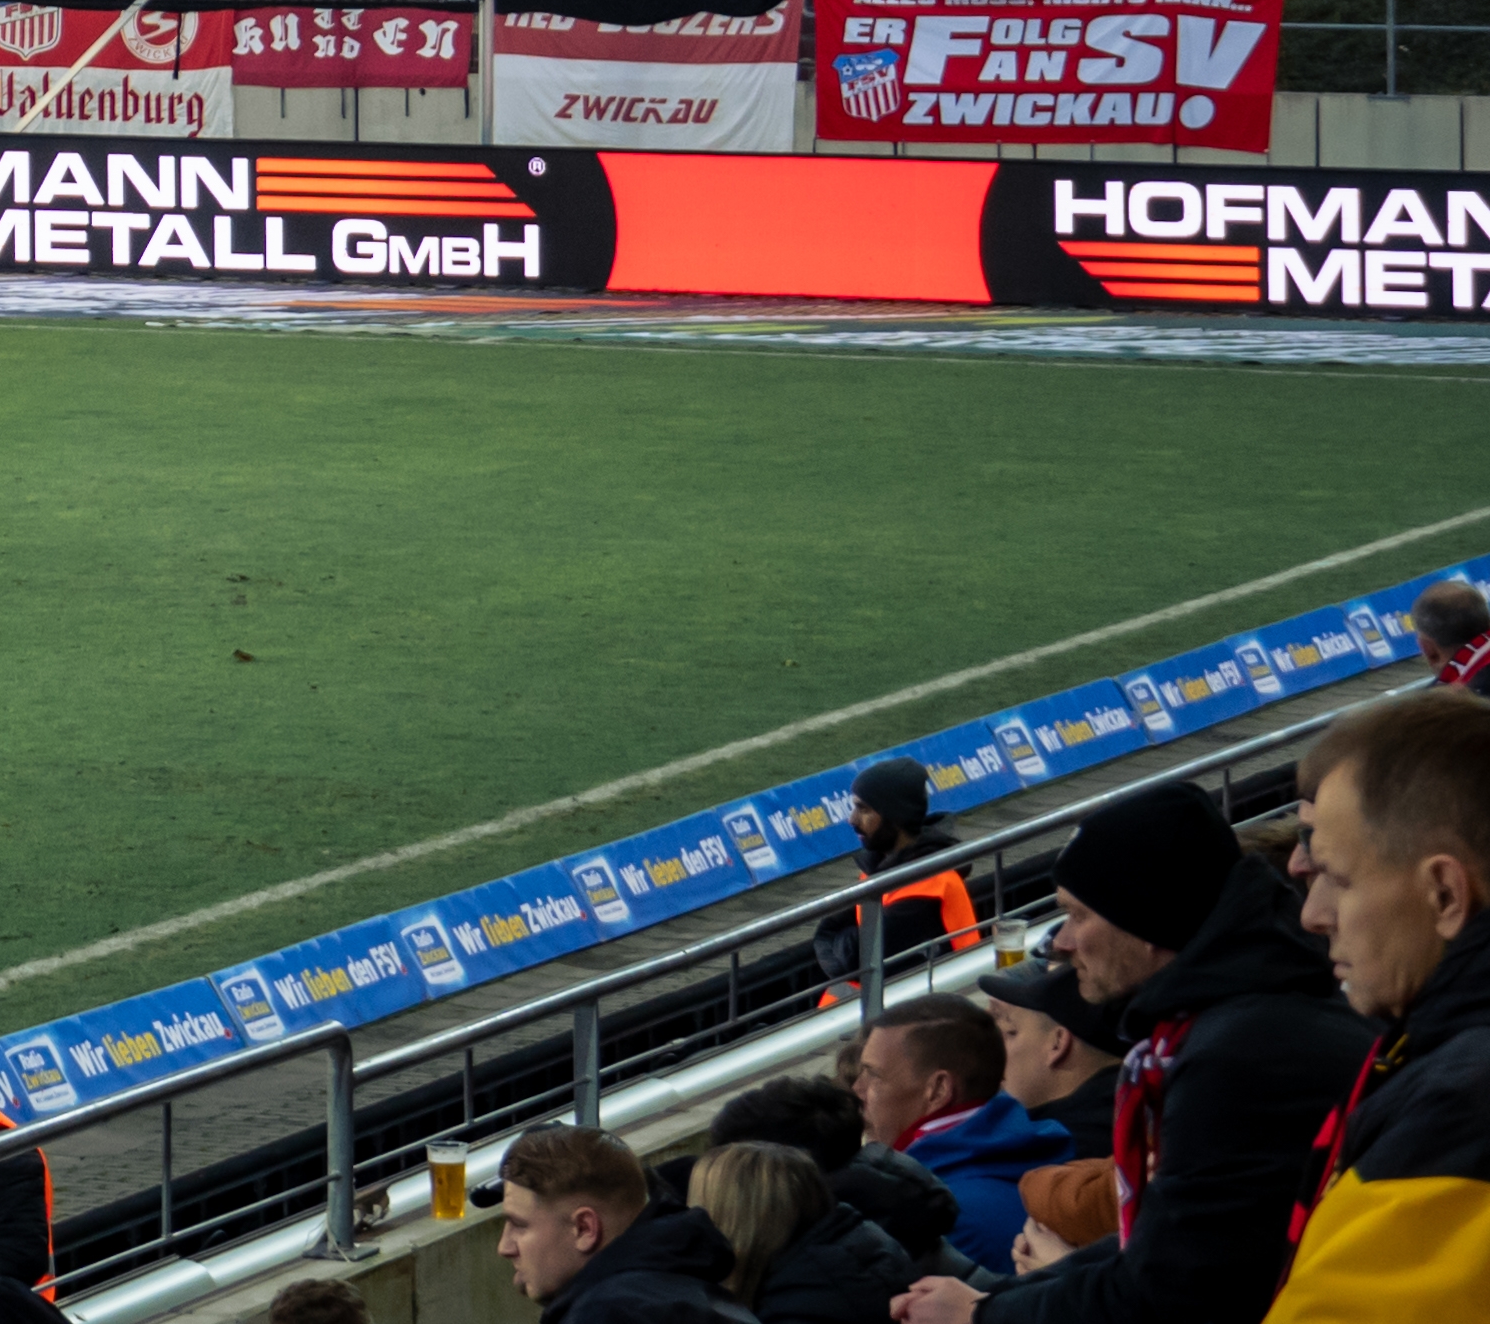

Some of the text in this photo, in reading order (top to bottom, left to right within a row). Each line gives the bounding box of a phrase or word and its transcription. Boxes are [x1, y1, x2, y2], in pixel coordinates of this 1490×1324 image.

[555, 93, 718, 125] ZWICKAU
[1054, 178, 1490, 247] HOFMAN
[274, 975, 310, 1010] Wir
[301, 967, 354, 1003] lieben
[347, 954, 378, 988] den
[69, 1039, 105, 1078] Wir
[102, 1031, 161, 1068] lieben
